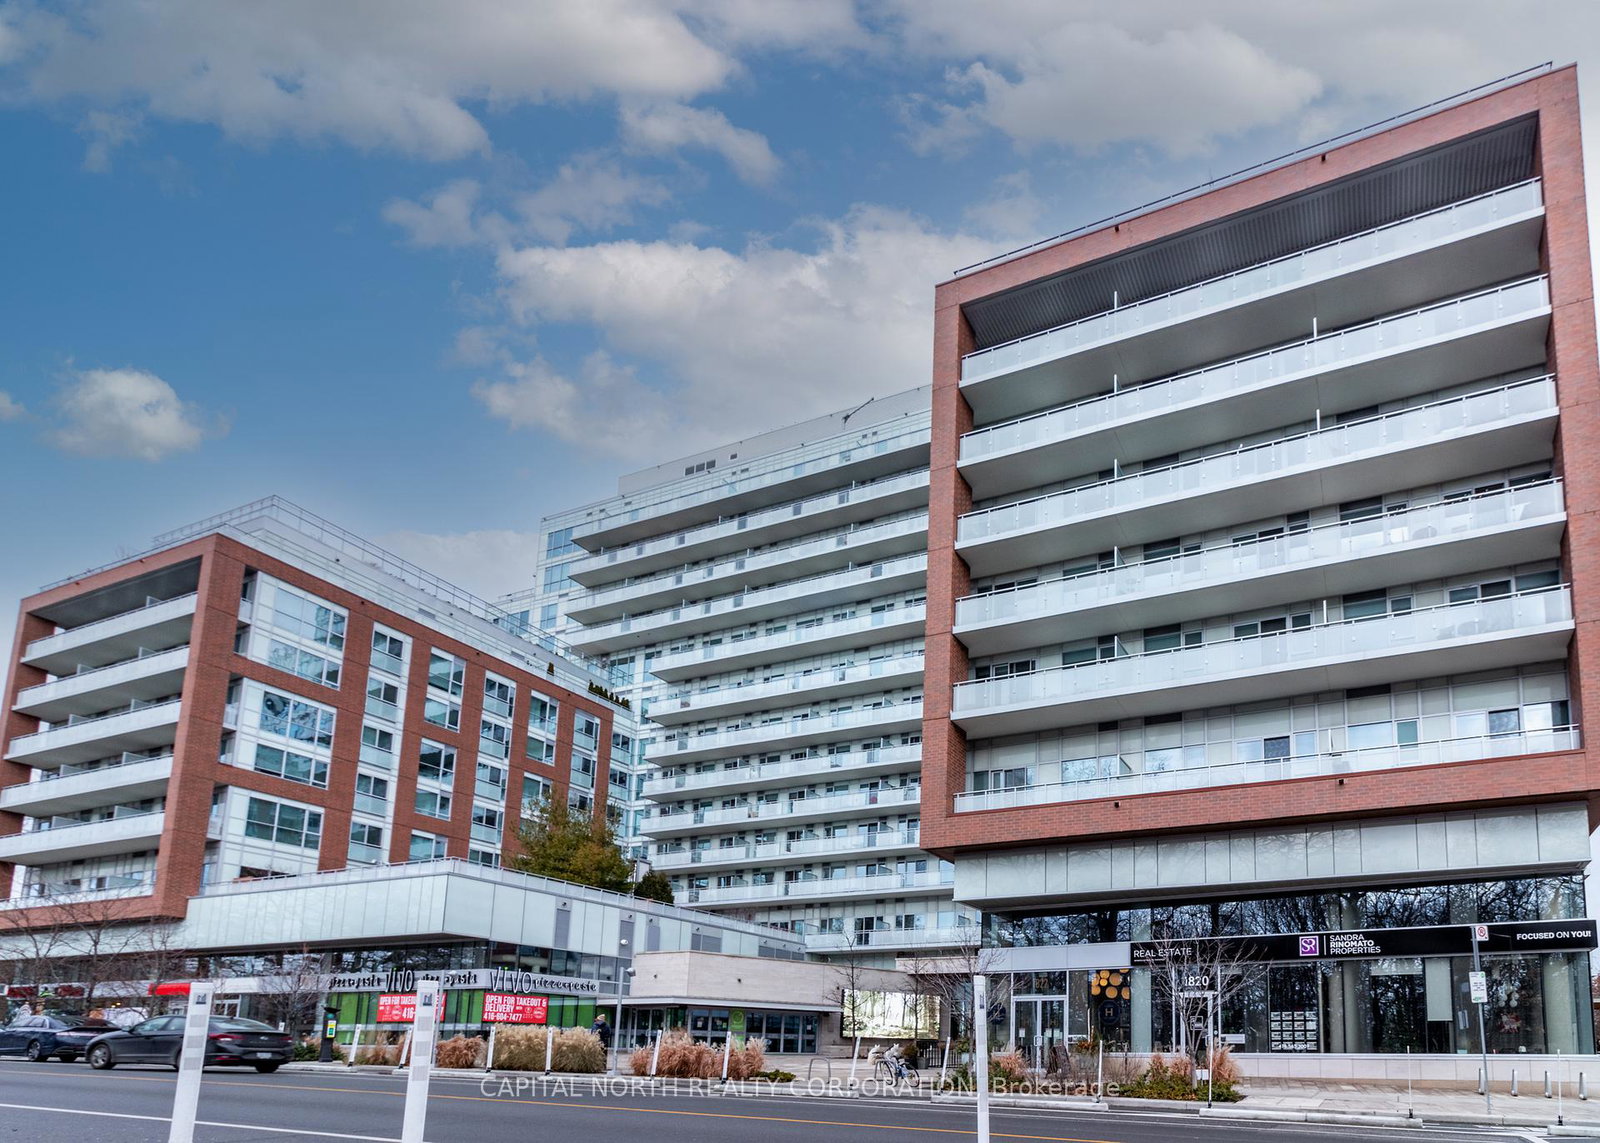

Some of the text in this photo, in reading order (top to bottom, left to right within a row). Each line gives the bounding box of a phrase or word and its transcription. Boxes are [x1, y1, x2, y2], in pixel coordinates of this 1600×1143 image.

[1516, 932, 1555, 940] FOCUSED
[1571, 930, 1592, 938] YOU!
[1330, 940, 1374, 948] RINOMATO
[1133, 947, 1192, 958] REAL ESTATE
[1330, 946, 1381, 954] PROPERTIES
[485, 995, 503, 1004] OPEN
[503, 996, 516, 1005] FOR
[516, 997, 541, 1006] TAKEOUT
[484, 1004, 514, 1012] DELIVERY
